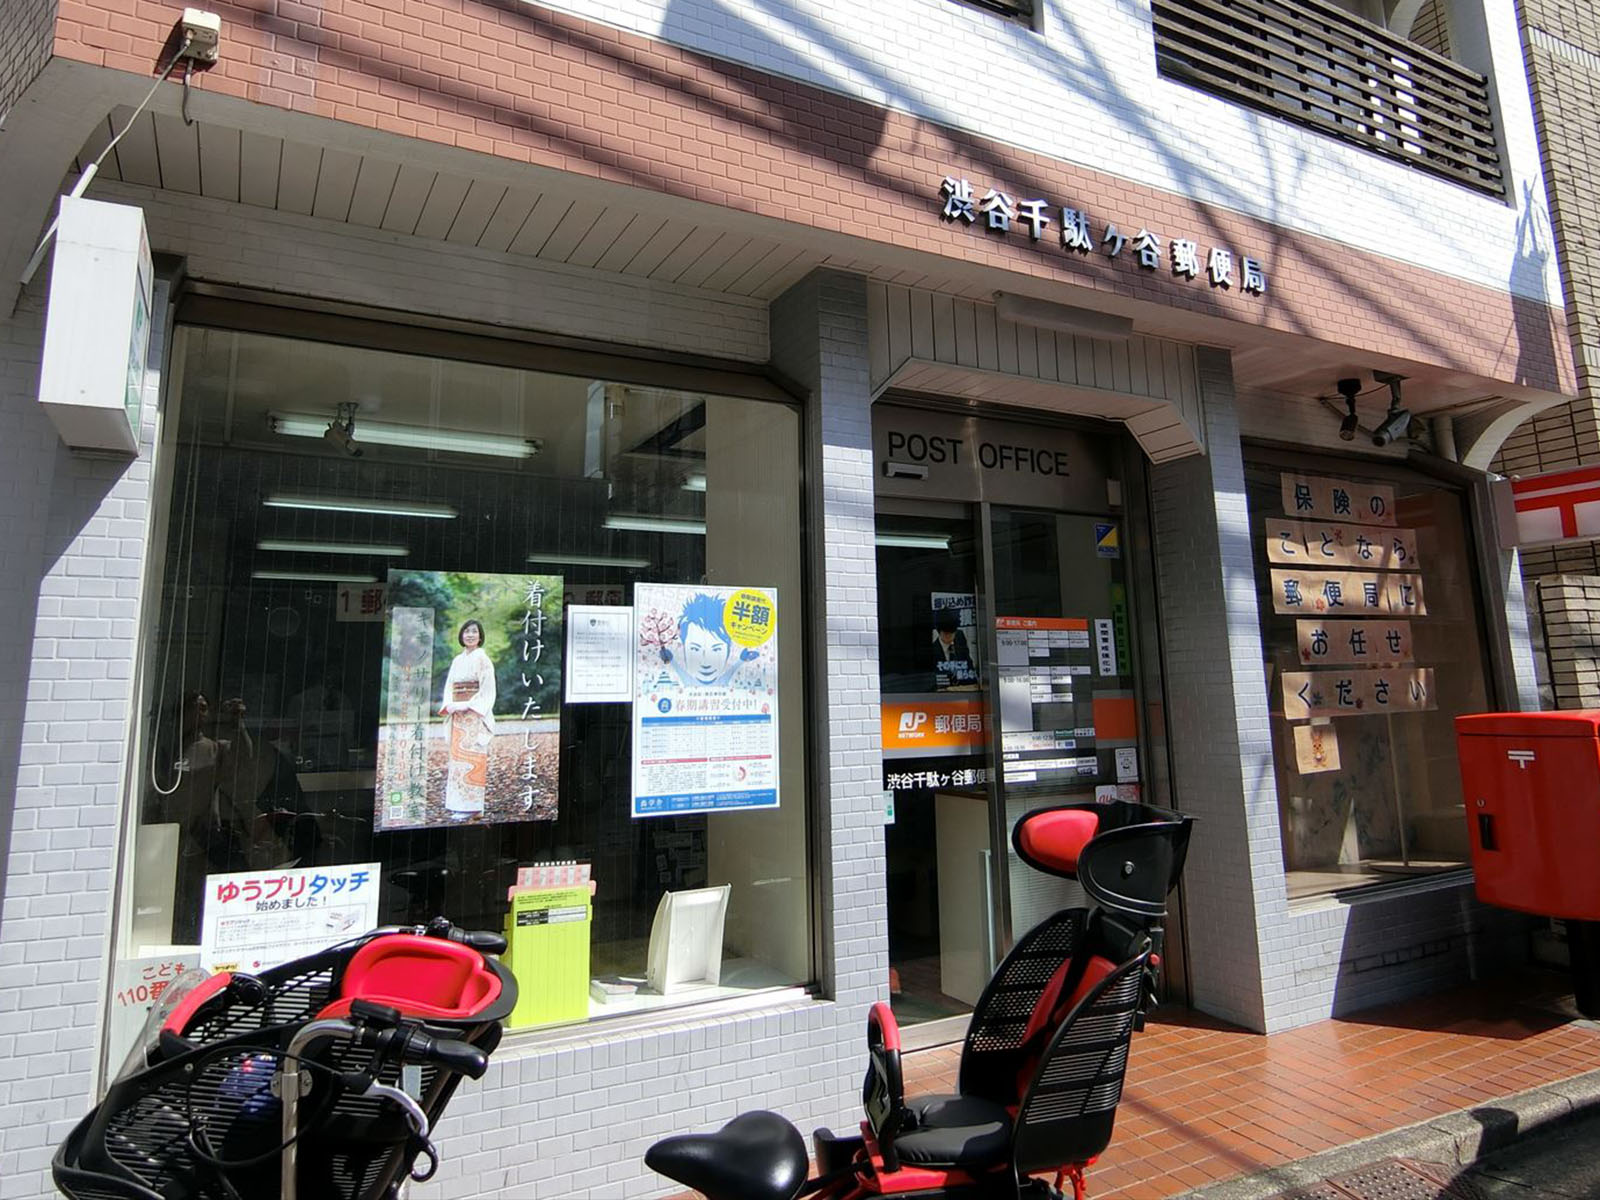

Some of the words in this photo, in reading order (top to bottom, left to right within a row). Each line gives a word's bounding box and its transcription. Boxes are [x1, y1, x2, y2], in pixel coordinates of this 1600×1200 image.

[941, 176, 1266, 292] 渋谷千駄ヶ谷郵便局
[888, 431, 963, 464] POST
[979, 443, 1069, 476] OFFICE
[1294, 483, 1386, 517] 保険の
[1280, 532, 1407, 561] ことなら
[1284, 579, 1414, 607] 郵便局に
[732, 601, 771, 627] 半額
[1310, 628, 1401, 656] お任せ
[521, 580, 547, 811] 着付けいたします
[1298, 679, 1427, 708] ください
[899, 712, 927, 732] JP
[935, 714, 982, 733] 郵便局
[217, 871, 368, 904] ゆうプリタッチ
[256, 896, 327, 912] 始めました！
[142, 962, 186, 981] こども
